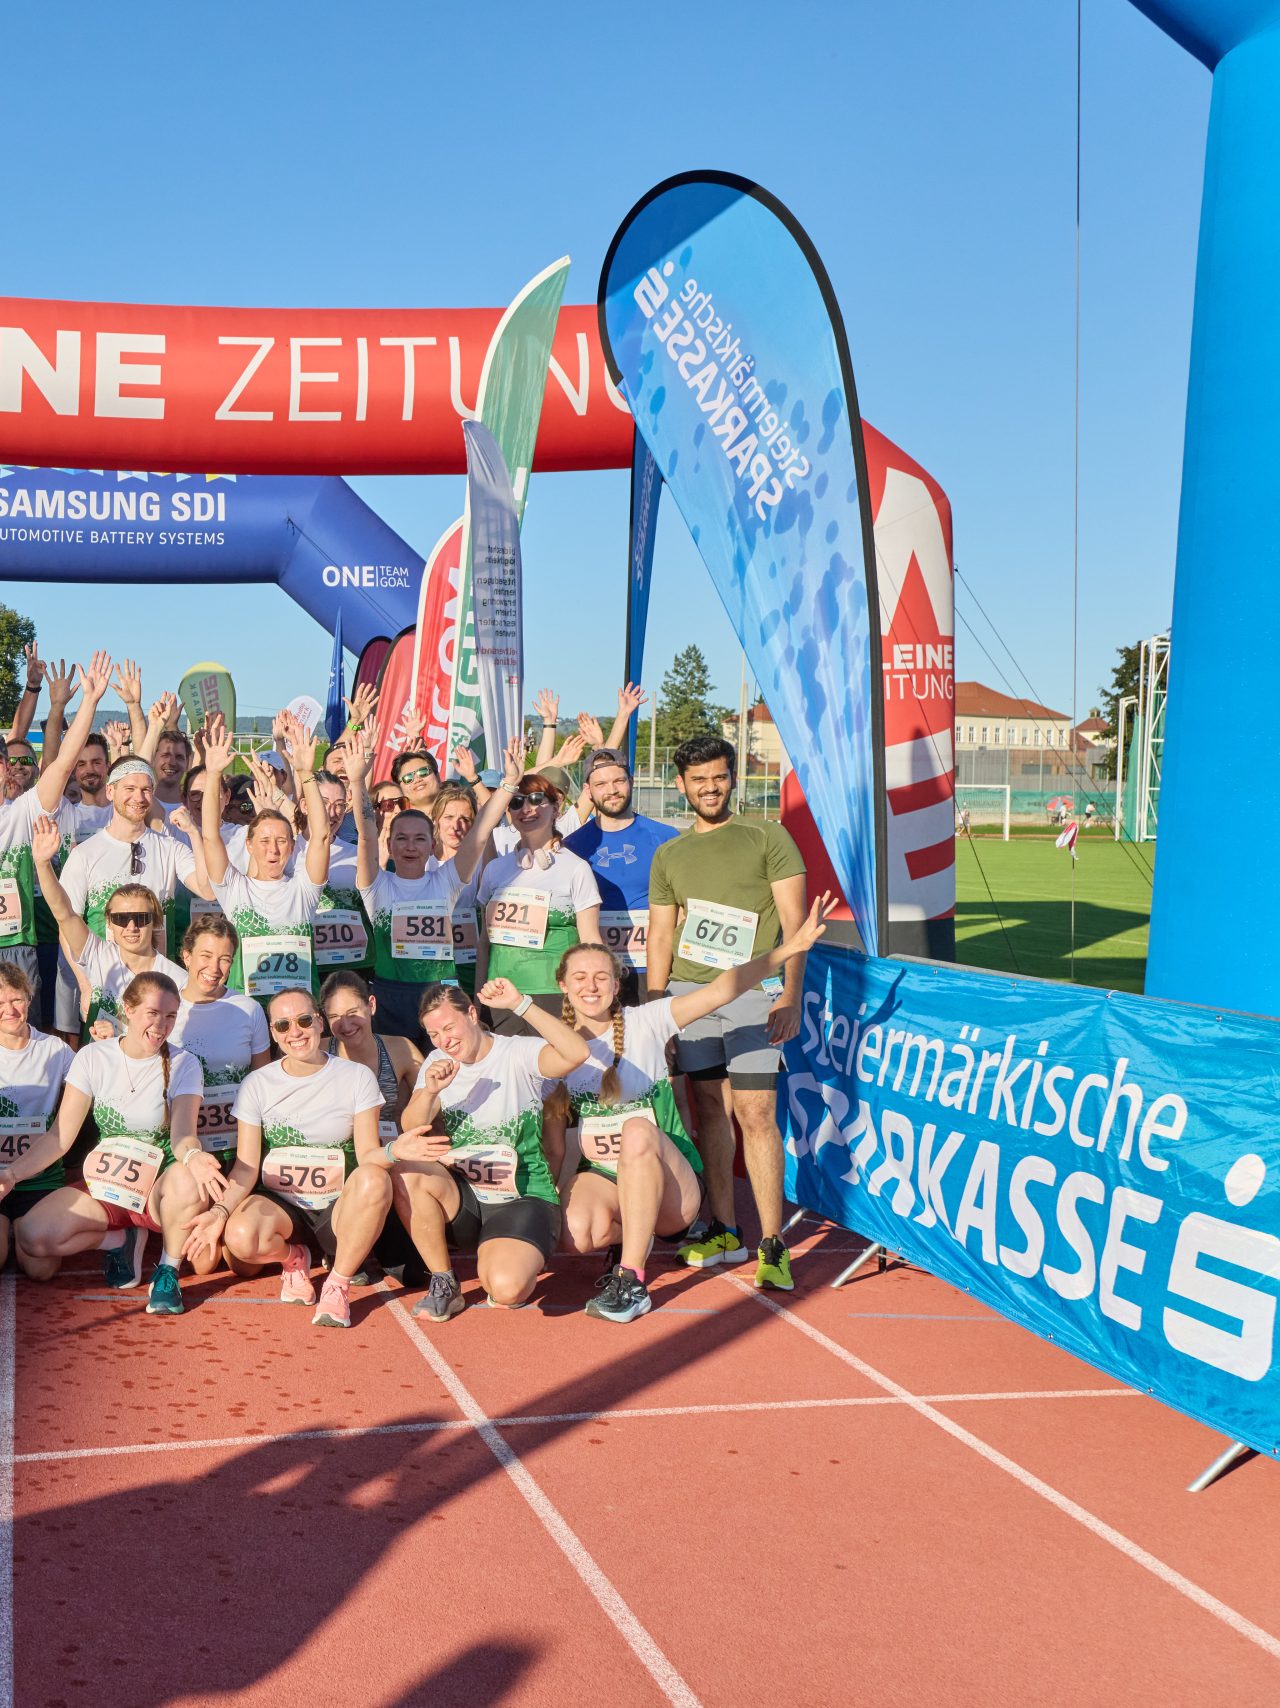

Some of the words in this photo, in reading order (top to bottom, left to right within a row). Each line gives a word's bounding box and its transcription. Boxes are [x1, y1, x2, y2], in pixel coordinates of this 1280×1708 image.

[171, 491, 226, 522] SDI
[89, 530, 154, 545] BATTERY
[159, 531, 225, 545] SYSTEMS
[322, 565, 375, 587] ONE
[380, 566, 409, 577] TEAM
[380, 576, 411, 588] GOAL
[494, 902, 531, 926] 321
[315, 924, 354, 944] 510
[405, 916, 446, 937] 581
[606, 925, 647, 946] 974
[695, 918, 738, 946] 676
[256, 952, 299, 973] 678
[800, 964, 1188, 1172] Steiermärkische
[95, 1152, 143, 1183] 575
[279, 1165, 327, 1188] 576
[786, 1071, 1162, 1331] SPARKASSE
